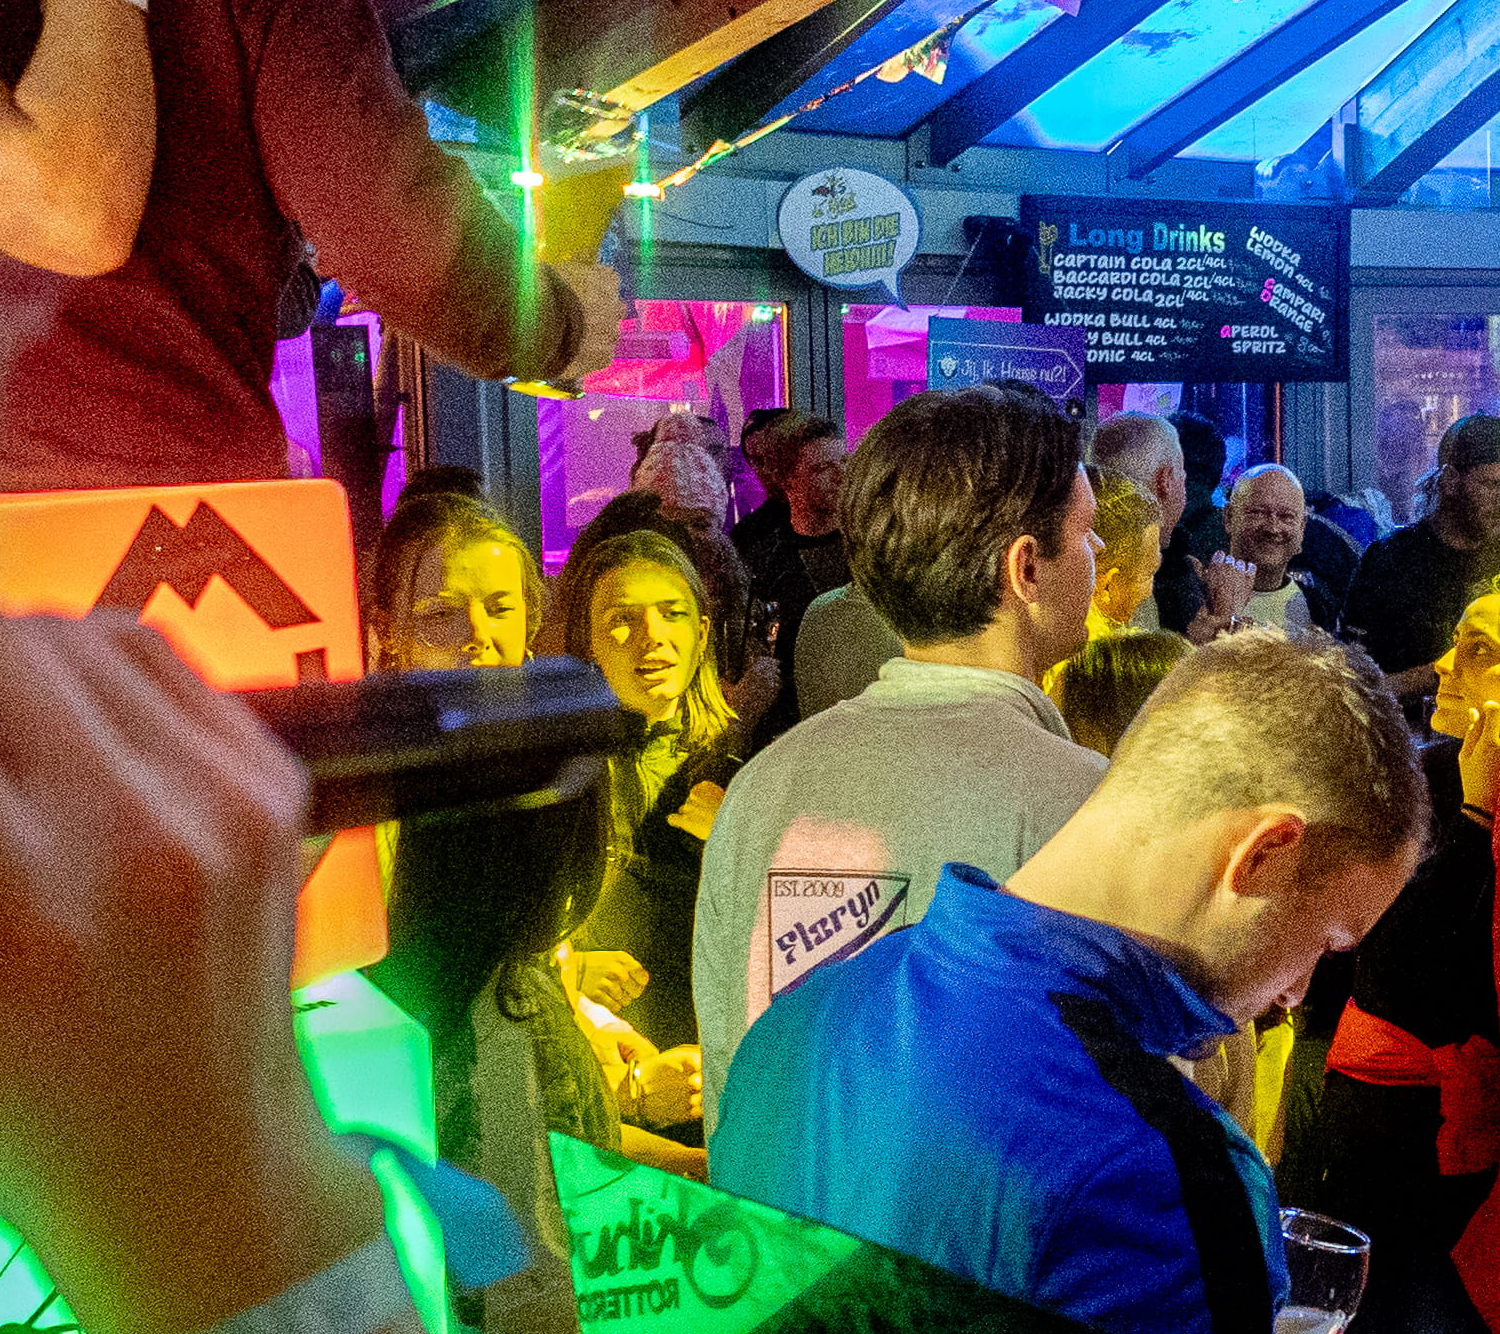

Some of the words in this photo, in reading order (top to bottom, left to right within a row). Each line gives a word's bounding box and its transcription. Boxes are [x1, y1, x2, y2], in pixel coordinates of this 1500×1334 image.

[1068, 222, 1144, 255] Long
[1151, 221, 1227, 253] Drinks
[1129, 255, 1173, 272] COLA
[1139, 270, 1181, 288] COLA
[1110, 285, 1153, 304] COLA
[1109, 313, 1151, 330] BULL
[1102, 330, 1143, 348] BULL
[1219, 323, 1279, 340] APEROL
[1231, 340, 1287, 355] SPRITZ
[1086, 348, 1126, 365] ONIC
[802, 879, 846, 899] 2009
